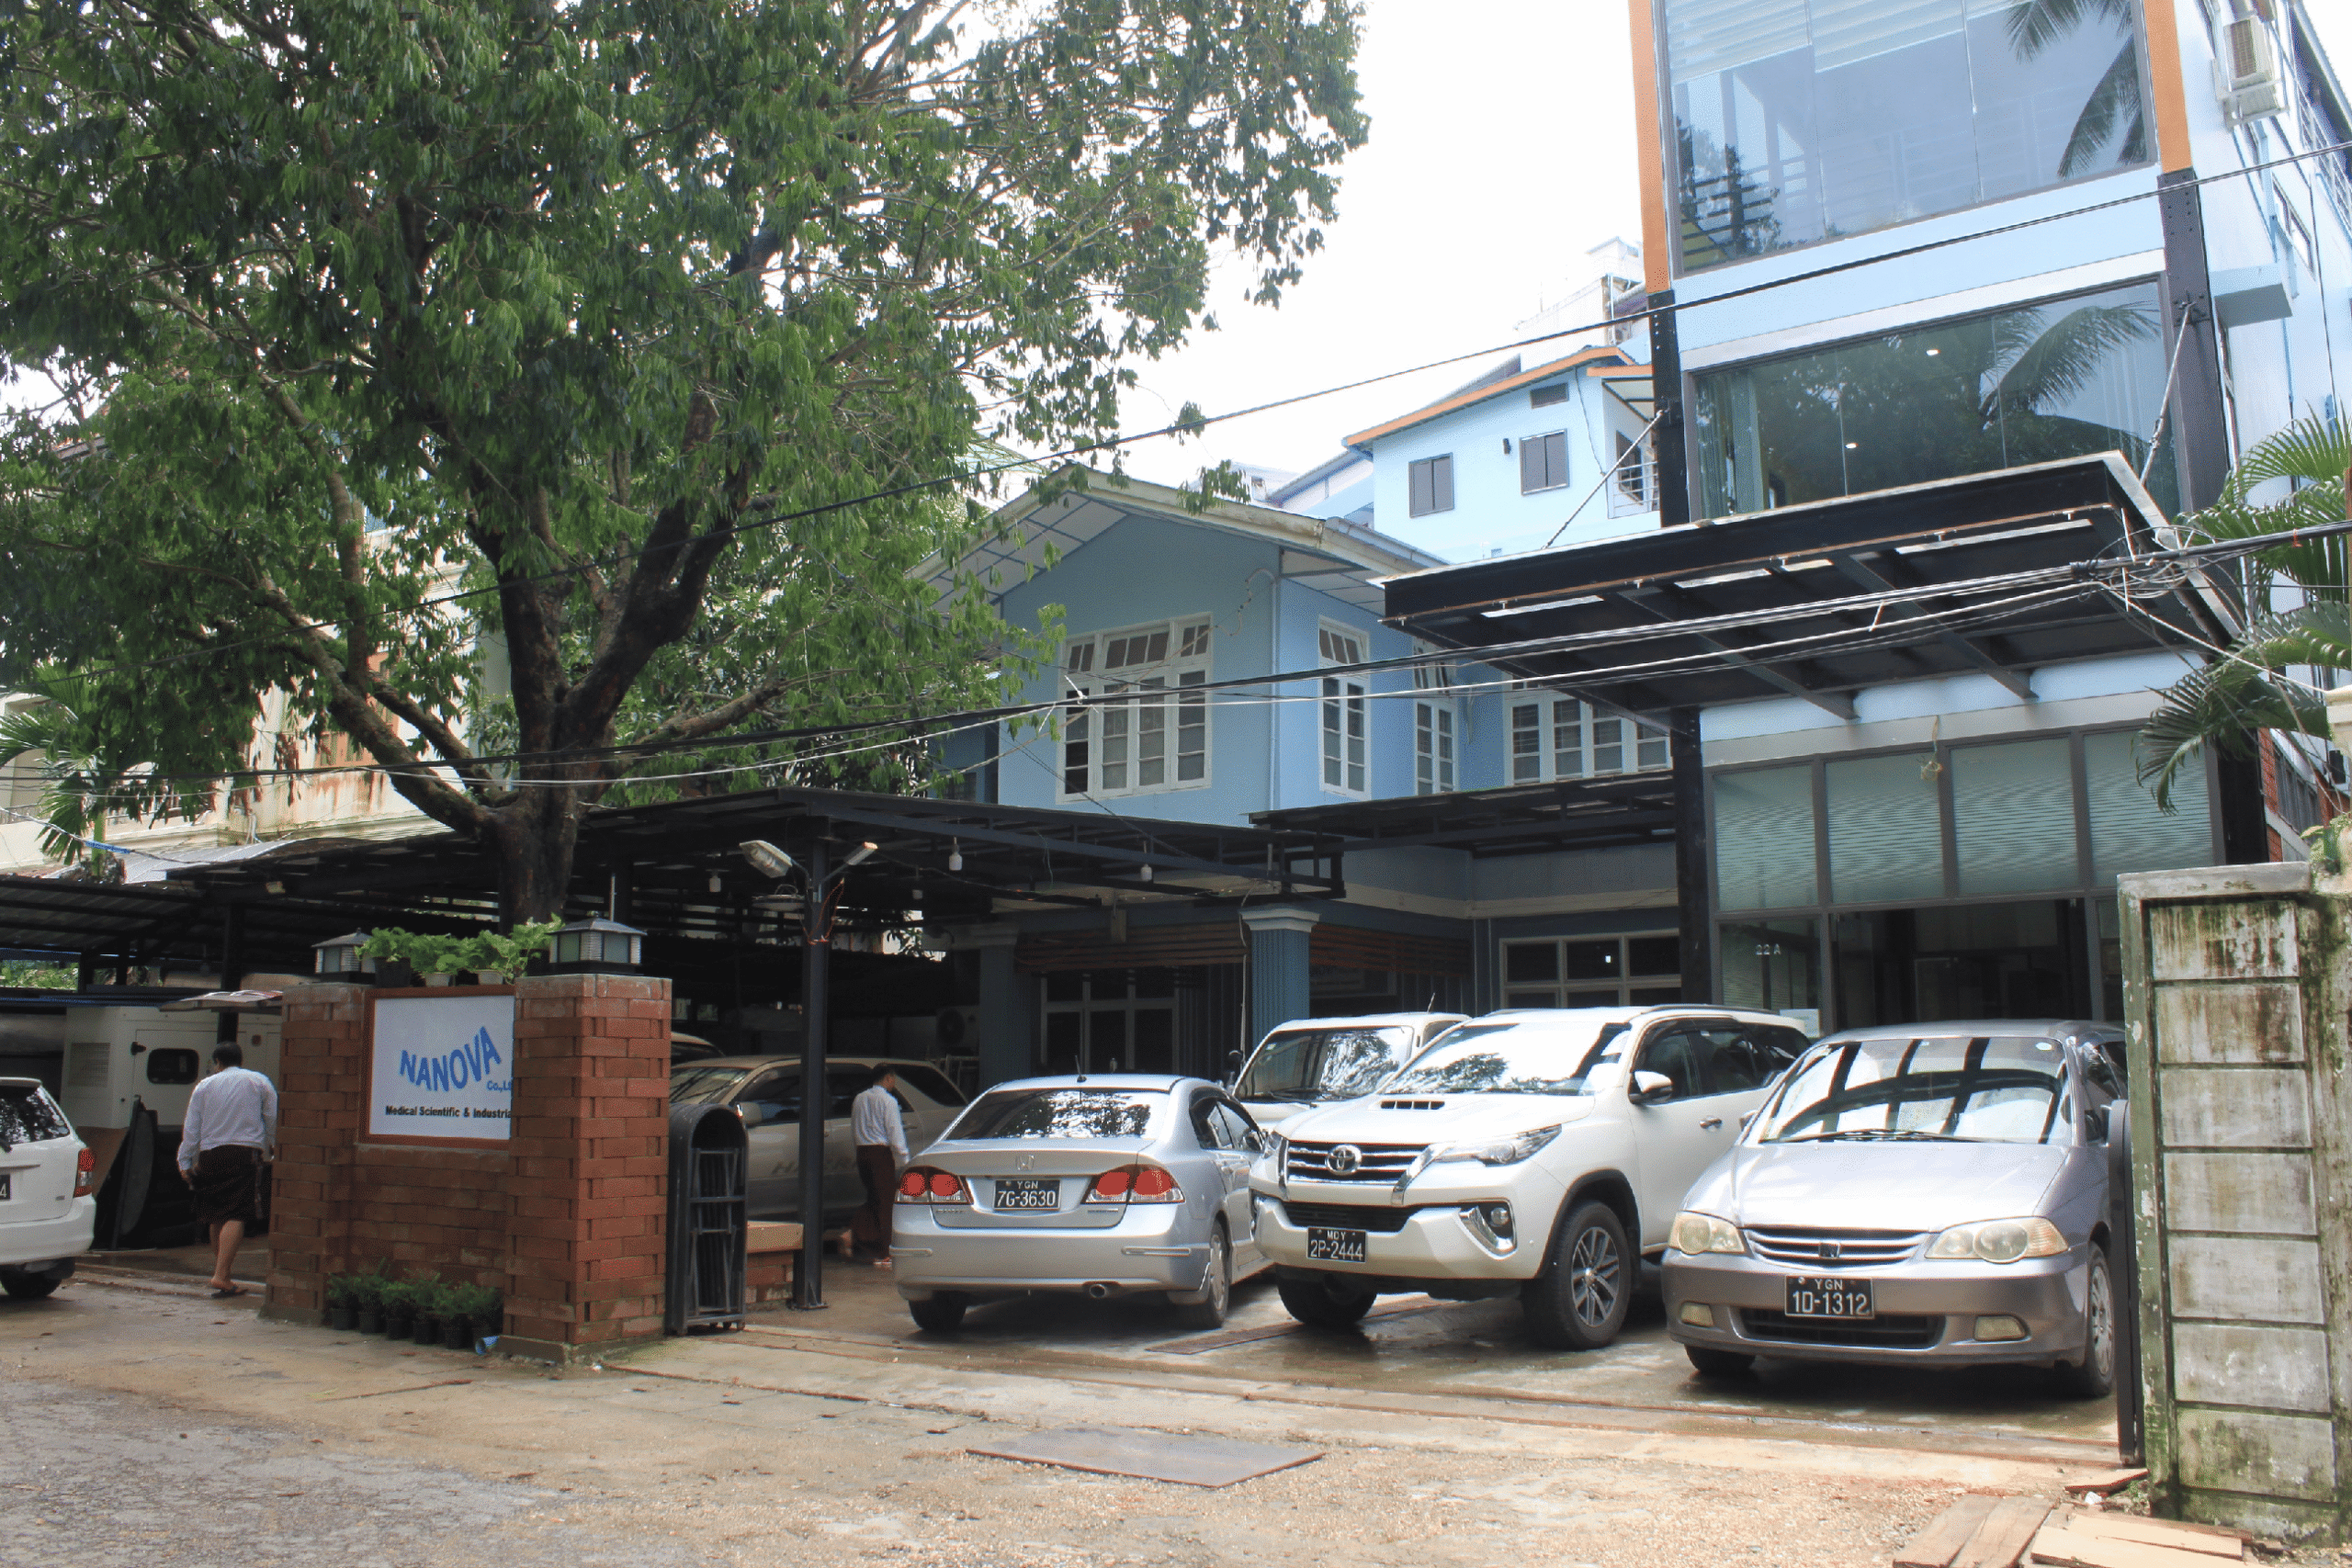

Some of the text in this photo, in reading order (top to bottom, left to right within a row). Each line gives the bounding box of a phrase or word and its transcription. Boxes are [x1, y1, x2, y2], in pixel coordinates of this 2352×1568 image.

[399, 1026, 502, 1092] NANOVA
[386, 1105, 512, 1118] Medical Scientific & Industria
[1016, 1180, 1038, 1190] YGN
[997, 1190, 1056, 1207] 7G-3630
[1327, 1230, 1346, 1241] MDY
[1310, 1239, 1363, 1260] 2P-2444
[1815, 1279, 1843, 1291] YGN
[1792, 1291, 1870, 1315] 1D-1312
